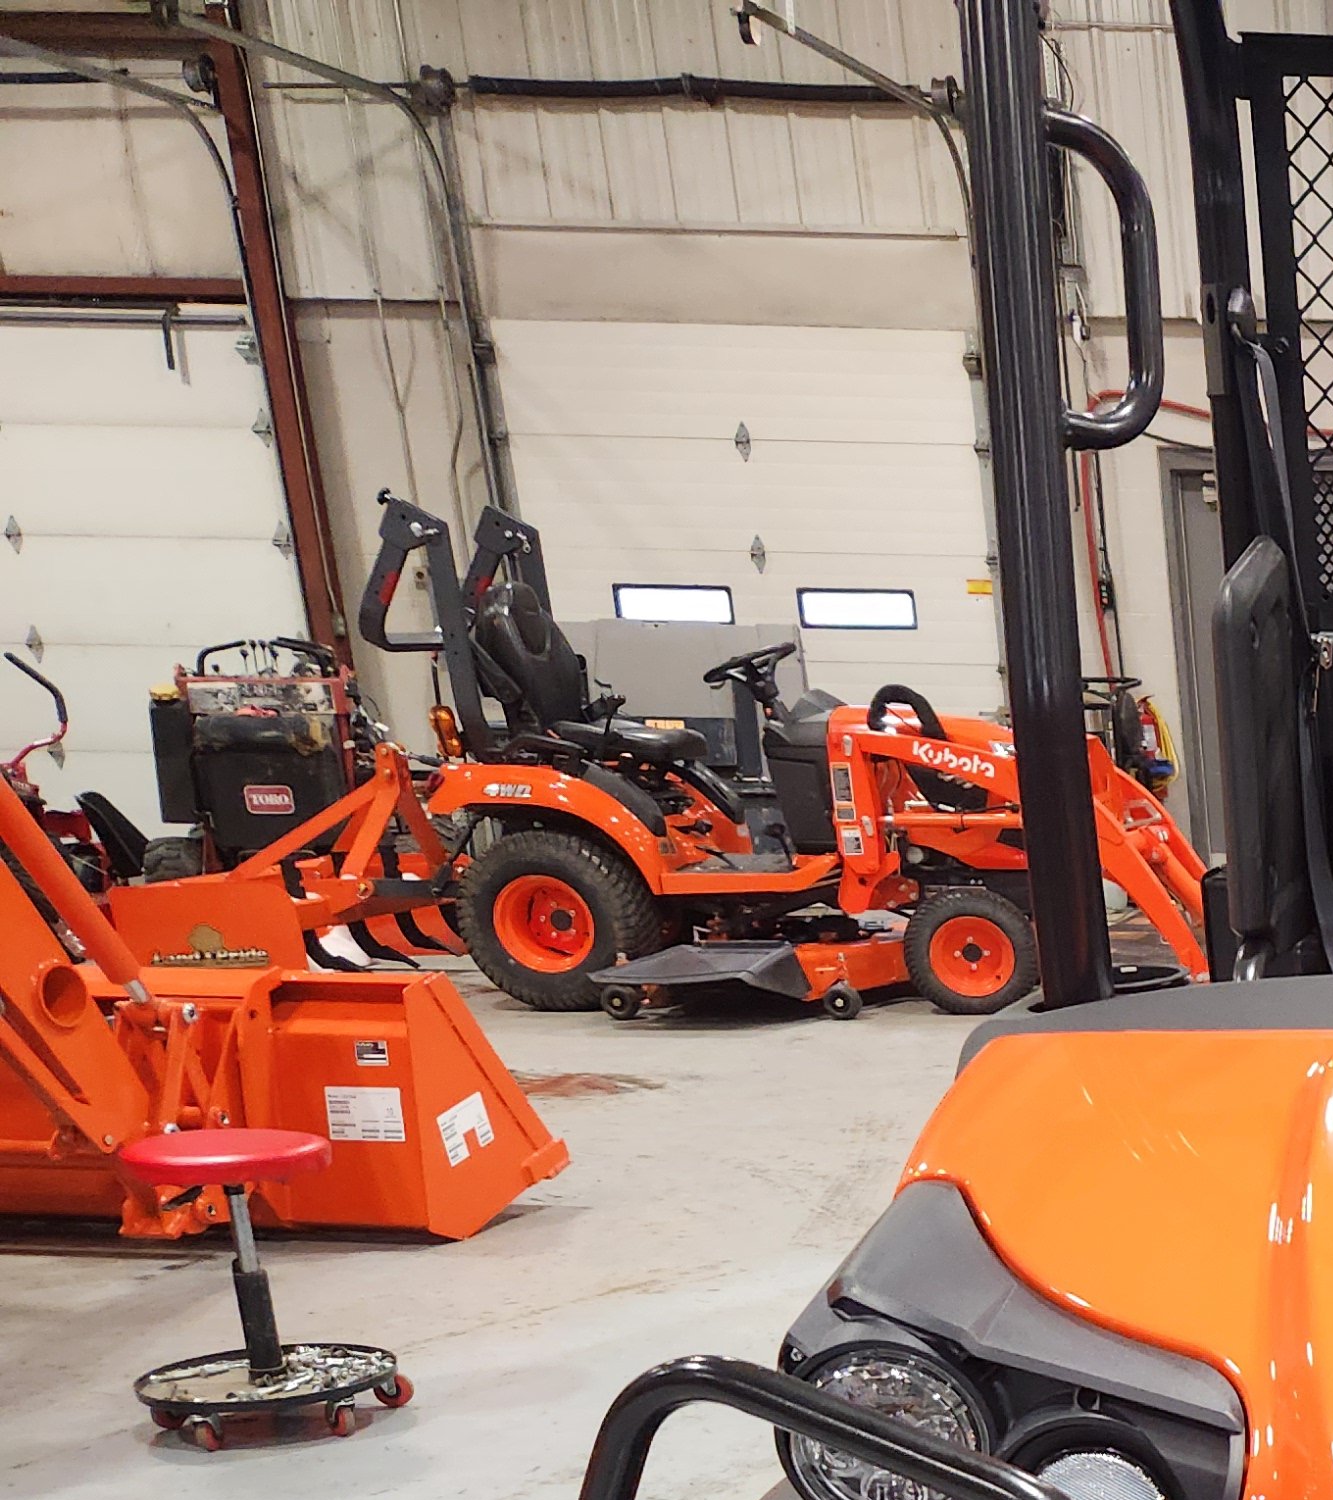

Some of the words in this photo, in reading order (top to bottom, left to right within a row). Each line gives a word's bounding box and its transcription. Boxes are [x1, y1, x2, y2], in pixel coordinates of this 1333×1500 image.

[912, 740, 995, 778] Kubota
[483, 783, 532, 798] 4WD
[249, 793, 290, 805] TORO
